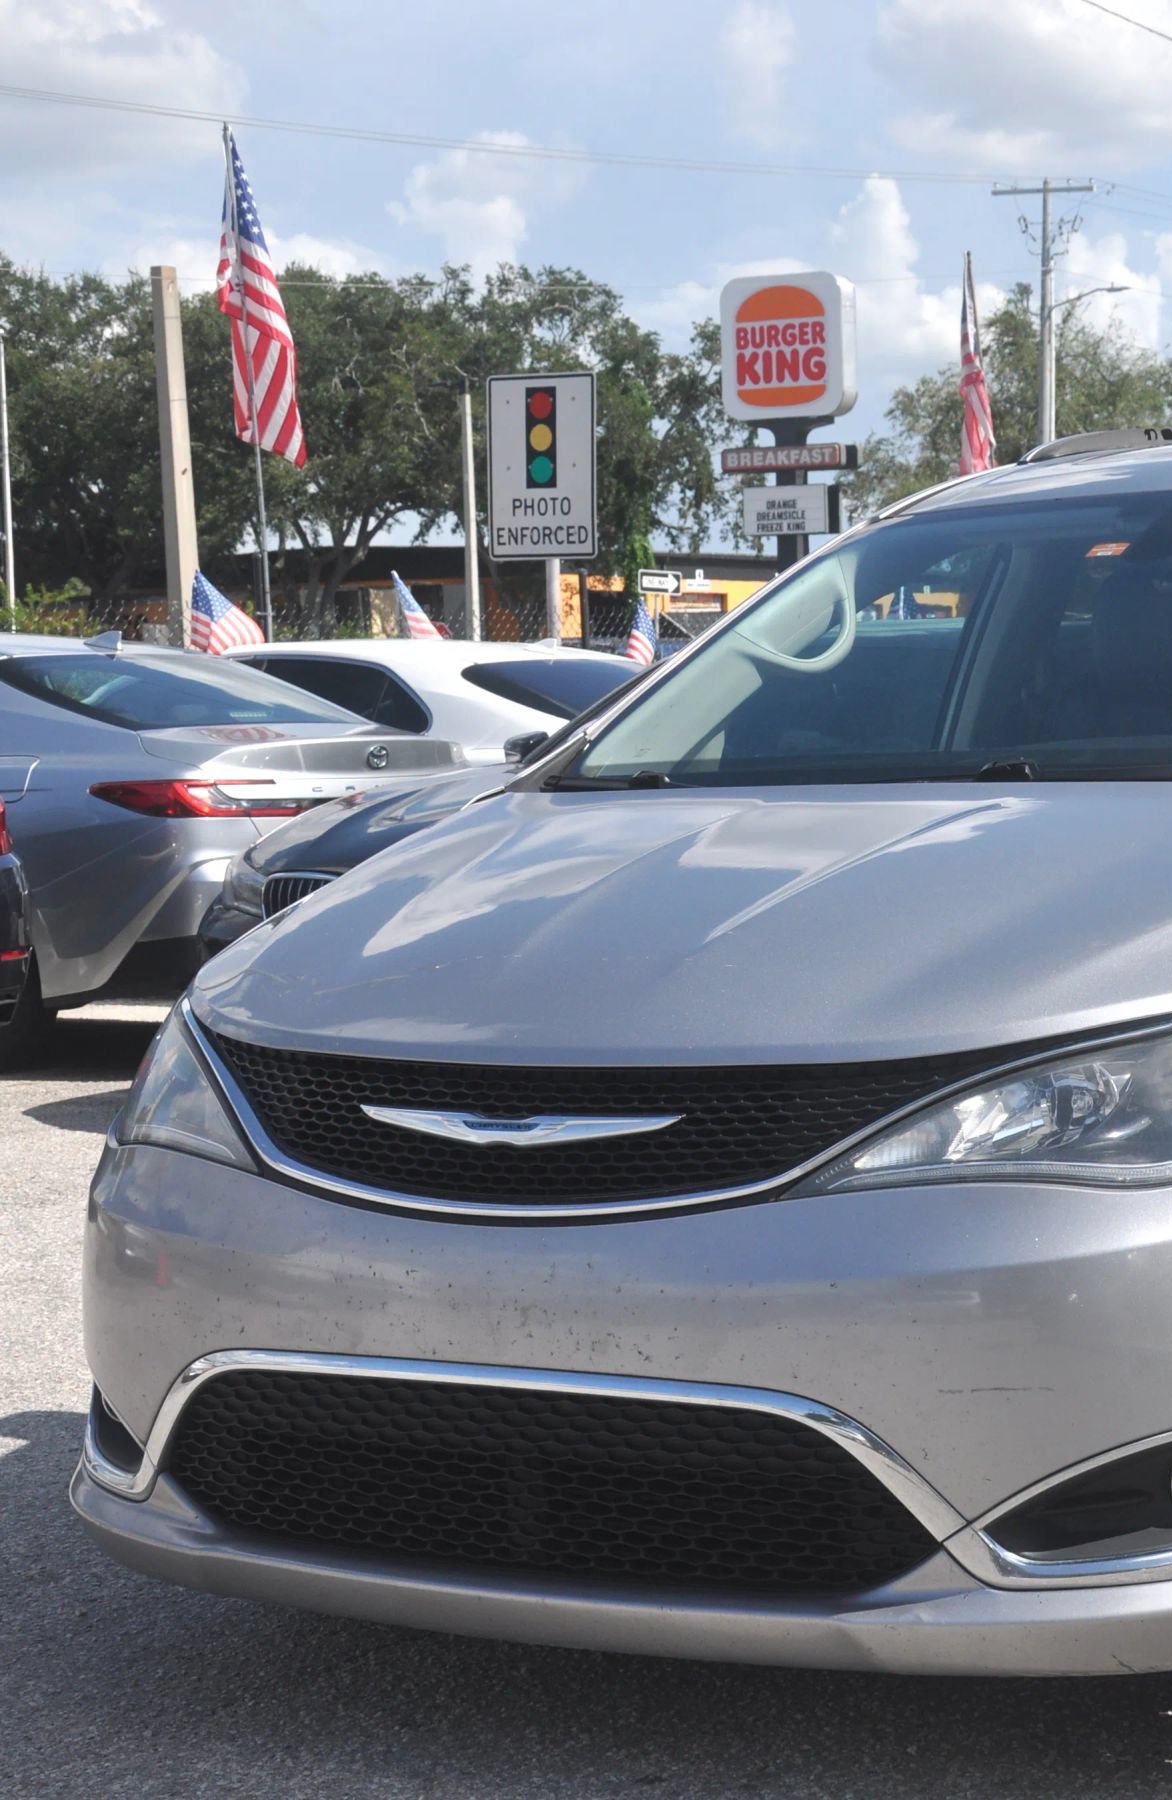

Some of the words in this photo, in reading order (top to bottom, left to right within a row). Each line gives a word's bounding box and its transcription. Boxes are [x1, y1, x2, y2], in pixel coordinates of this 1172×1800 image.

[736, 321, 826, 350] BURGER
[736, 346, 827, 386] KING
[727, 448, 833, 468] BREAKFAST
[512, 496, 571, 517] PHOTO
[766, 499, 797, 510] ORANGE
[756, 510, 806, 522] DREAMSICLE
[496, 525, 588, 546] ENFORCED
[756, 522, 784, 533] FREEZE
[787, 521, 806, 532] KING
